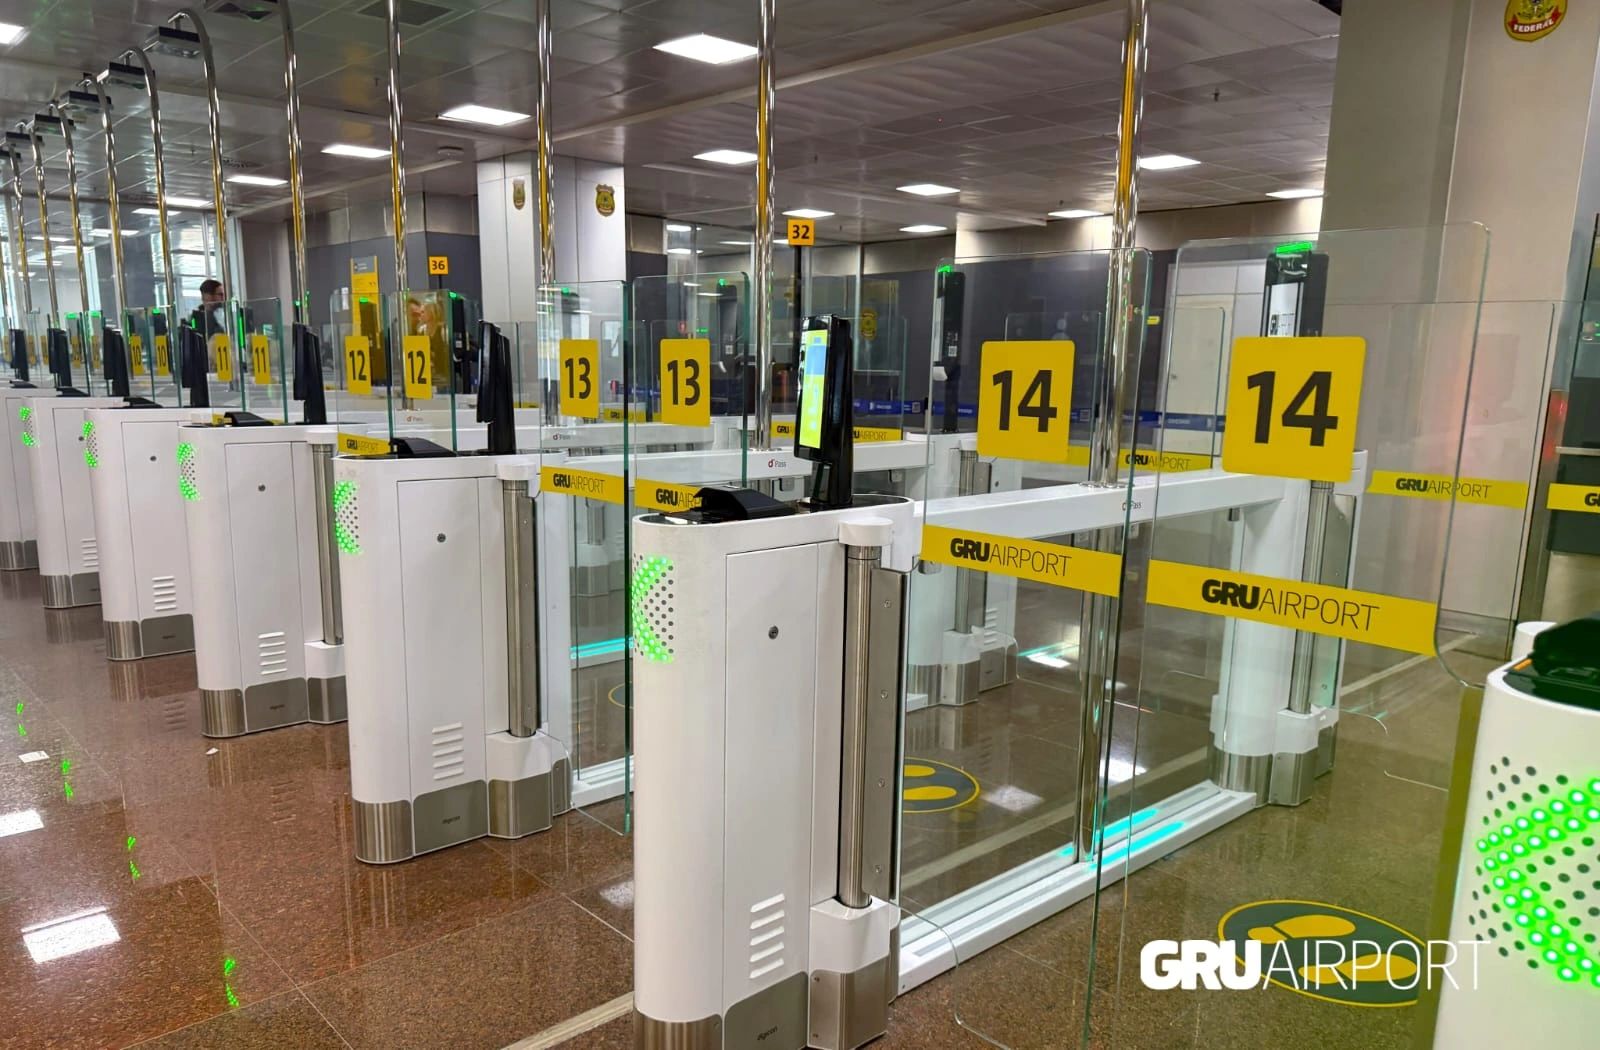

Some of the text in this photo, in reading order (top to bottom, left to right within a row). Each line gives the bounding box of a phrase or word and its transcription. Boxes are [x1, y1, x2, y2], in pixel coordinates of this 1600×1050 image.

[1513, 18, 1554, 33] FEDERAL
[792, 225, 810, 239] 32
[431, 260, 445, 270] 36
[133, 345, 141, 366] 10
[157, 345, 167, 367] 10
[217, 346, 229, 371] 11
[255, 346, 267, 373] 11
[349, 350, 367, 381] 12
[408, 351, 427, 385] 12
[564, 357, 591, 399] 13
[667, 358, 700, 406] 13
[992, 369, 1058, 433] 14
[1247, 371, 1338, 447] 14
[553, 473, 606, 494] GRUAIRPORT
[950, 537, 1073, 577] GRUAIRPORT
[1201, 579, 1380, 631] GRUAIRPORT
